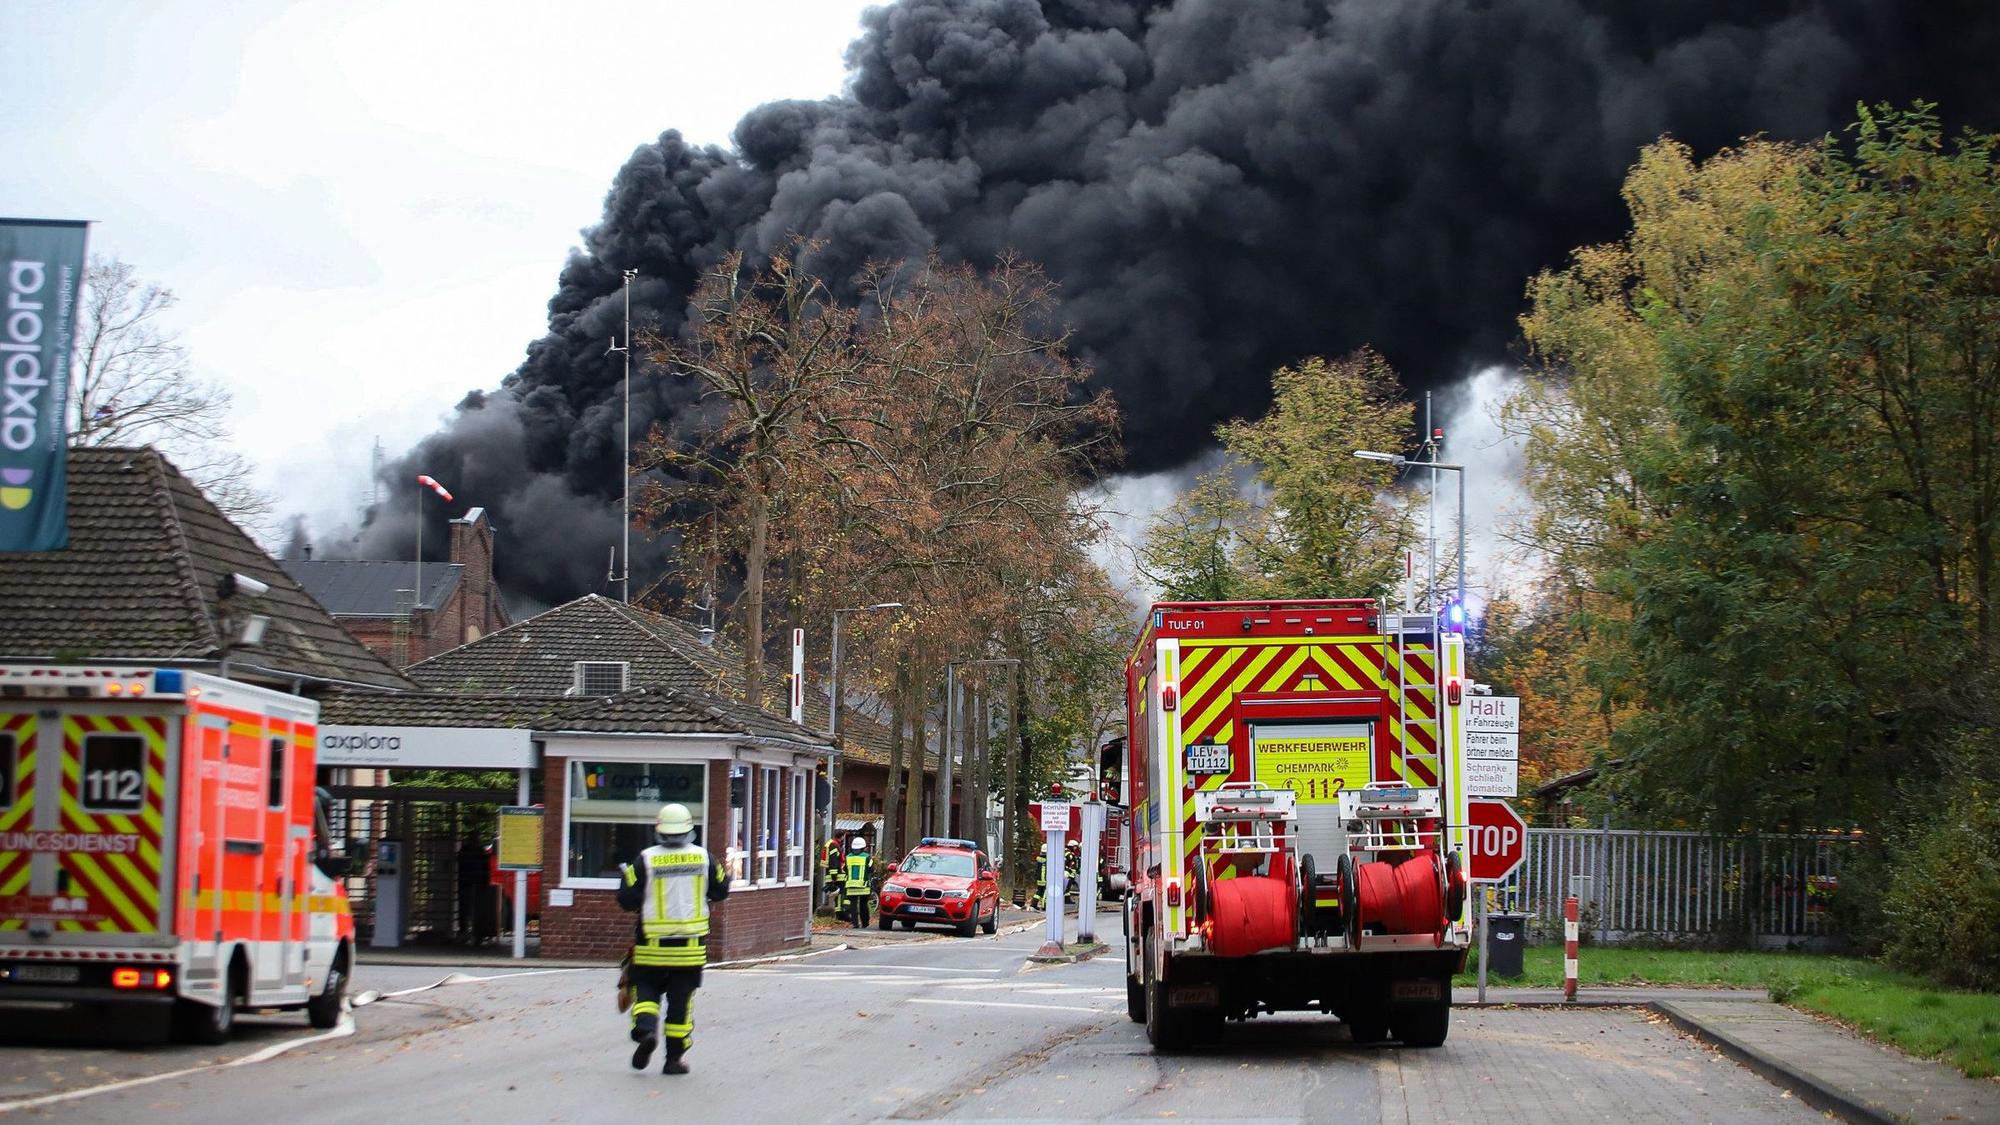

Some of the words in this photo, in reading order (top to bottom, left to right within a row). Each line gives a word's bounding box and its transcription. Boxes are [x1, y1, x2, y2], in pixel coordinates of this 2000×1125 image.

[59, 264, 73, 317] explorer.
[0, 261, 48, 451] axplora
[1168, 620, 1192, 630] TULF
[1194, 620, 1204, 630] 01
[1470, 700, 1506, 716] Halt
[1473, 718, 1515, 729] Fahrzeuge
[324, 732, 401, 753] axplora
[1466, 733, 1488, 744] Fahrer
[1490, 735, 1507, 745] beim
[1193, 746, 1213, 758] LEV
[1258, 741, 1366, 753] WERKFEUERWEHR
[1466, 746, 1487, 757] örtner
[1489, 747, 1514, 758] melden
[1191, 758, 1204, 768] TU
[1206, 758, 1226, 768] 112
[1276, 762, 1335, 773] CHEMPARK
[1466, 763, 1507, 773] Schranke
[1469, 773, 1503, 783] schließt
[88, 769, 141, 800] 112
[1307, 778, 1345, 799] 112
[1469, 824, 1518, 857] TOP
